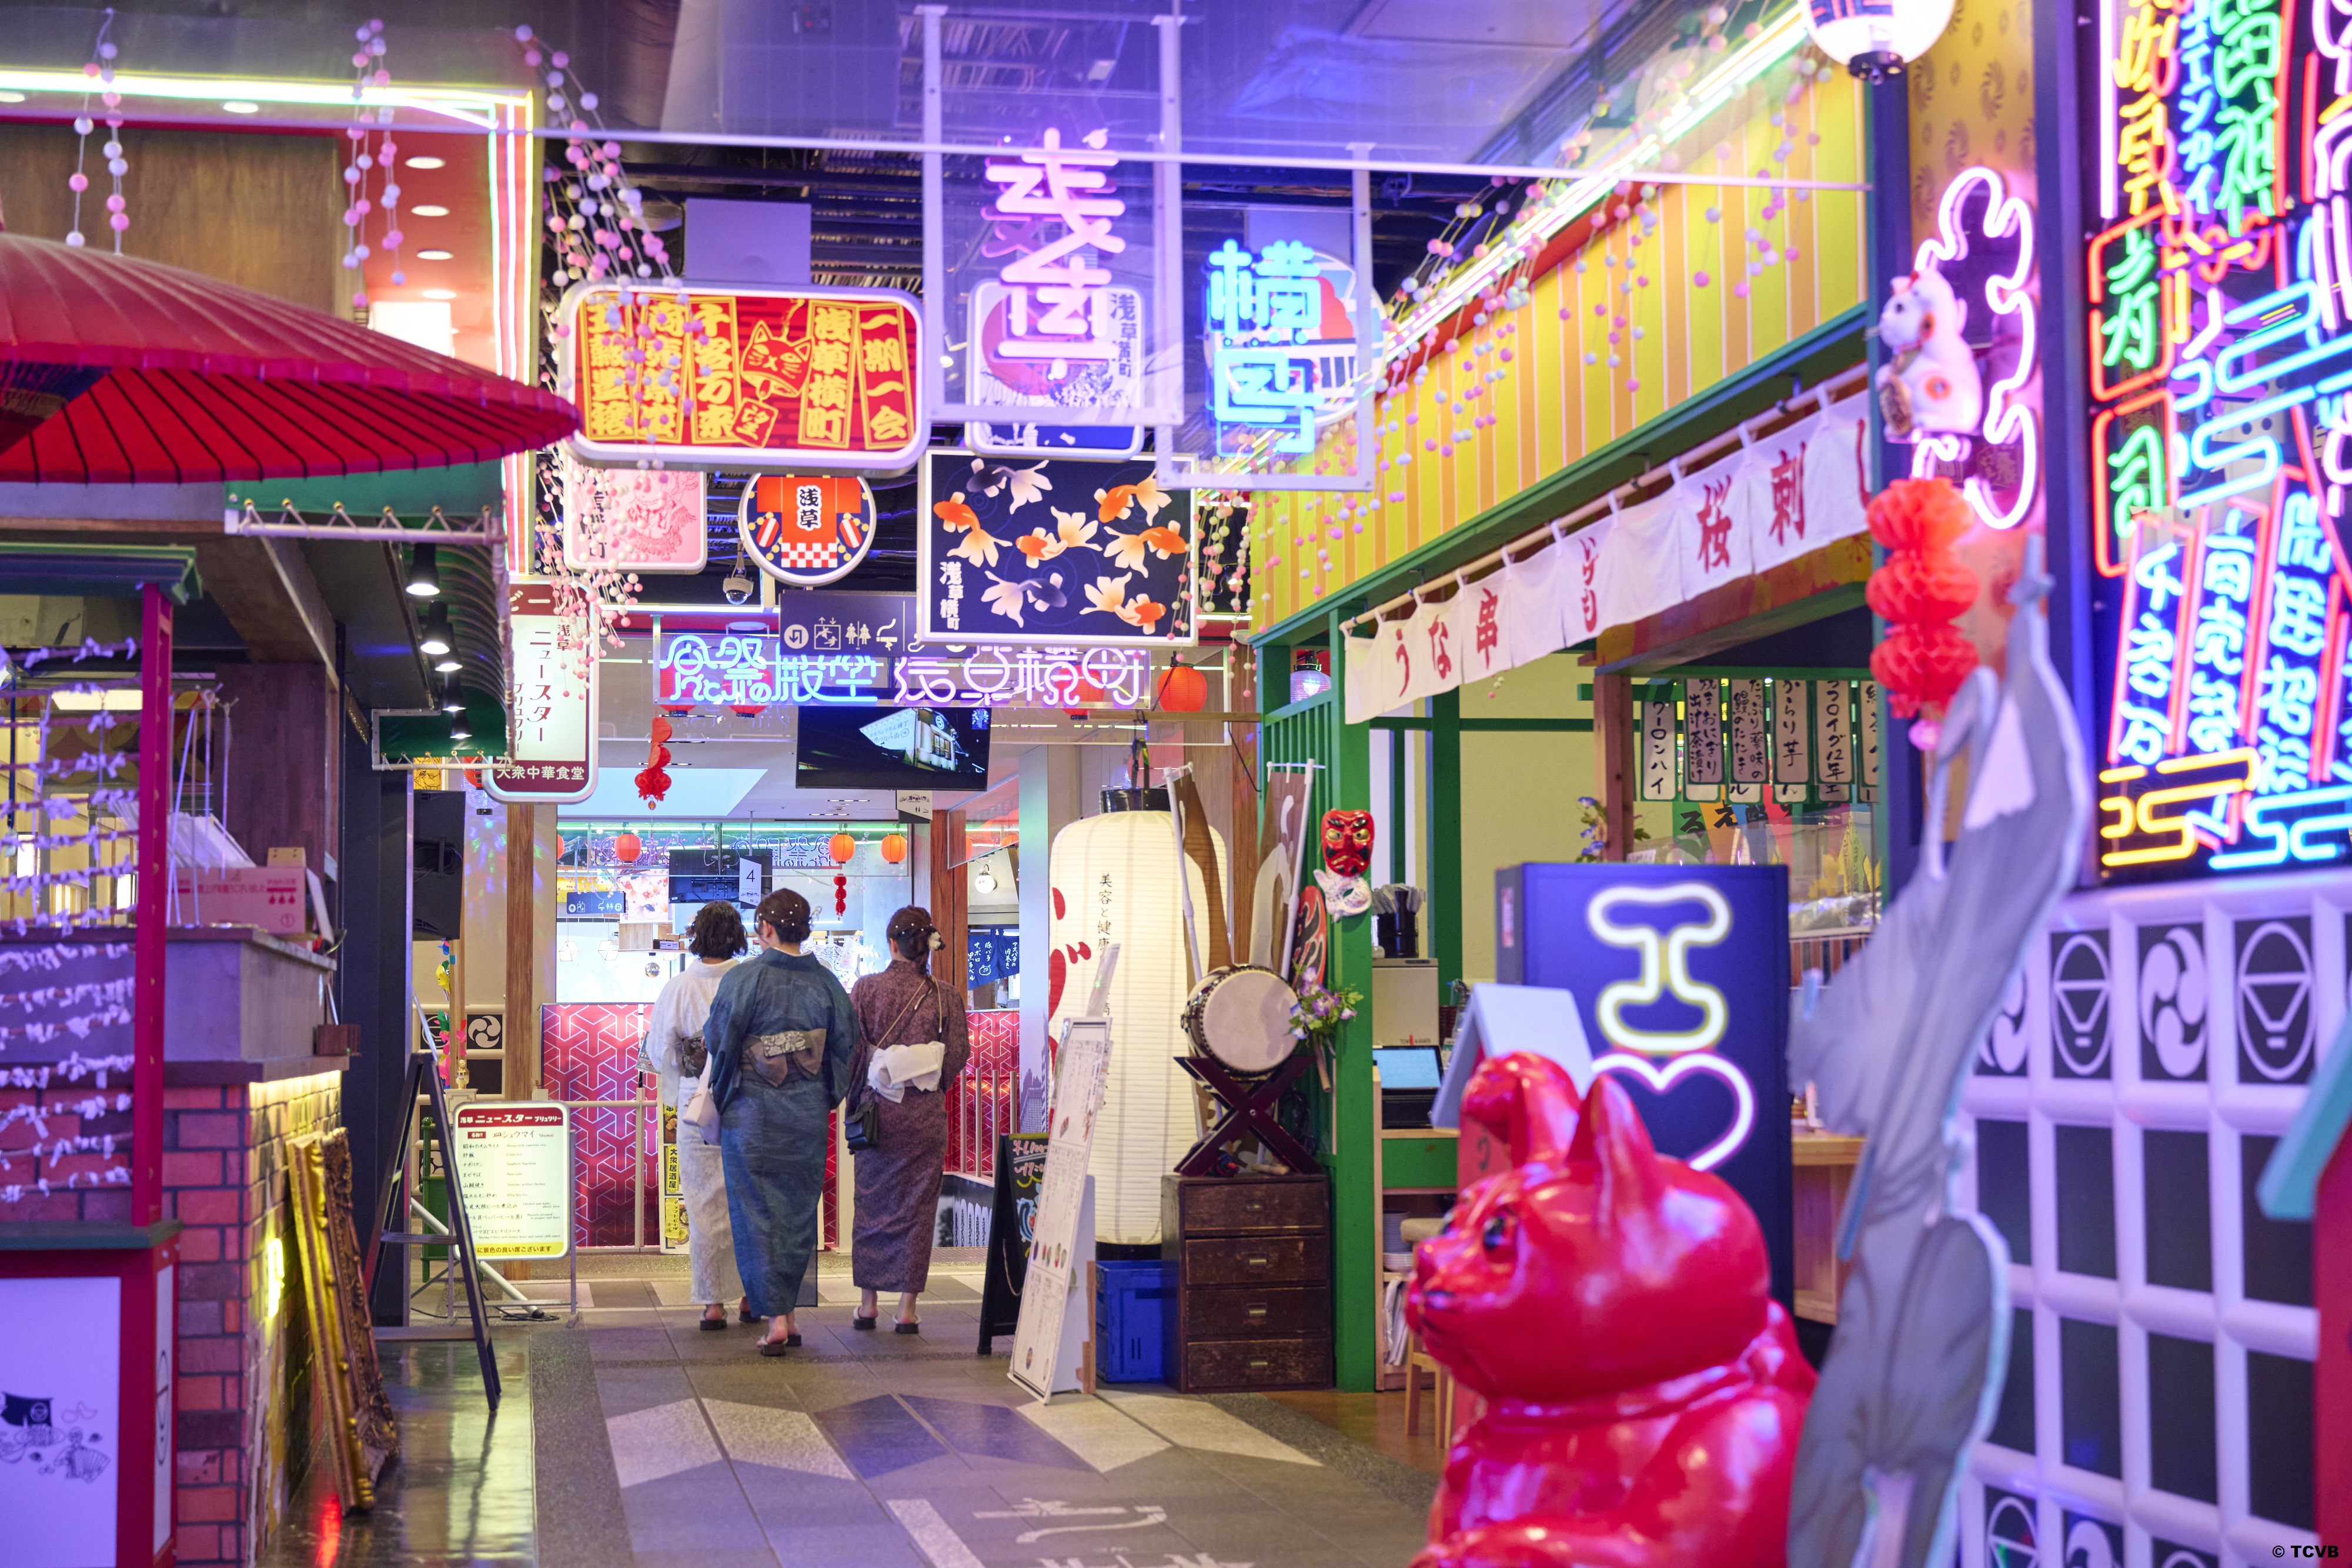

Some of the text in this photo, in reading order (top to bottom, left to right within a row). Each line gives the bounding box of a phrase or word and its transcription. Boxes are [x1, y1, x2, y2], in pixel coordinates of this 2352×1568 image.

[807, 307, 853, 443] 浅草横町
[860, 313, 907, 442] 一期一会
[797, 484, 823, 531] 浅草
[939, 561, 964, 631] 浅草横町
[1396, 588, 1498, 698] うな串
[527, 631, 552, 743] ニュースター
[496, 765, 584, 781] 大衆中華食堂
[746, 869, 755, 882] 4
[475, 1114, 532, 1124] ニュースター
[669, 1148, 677, 1188] 大衆居酒屋
